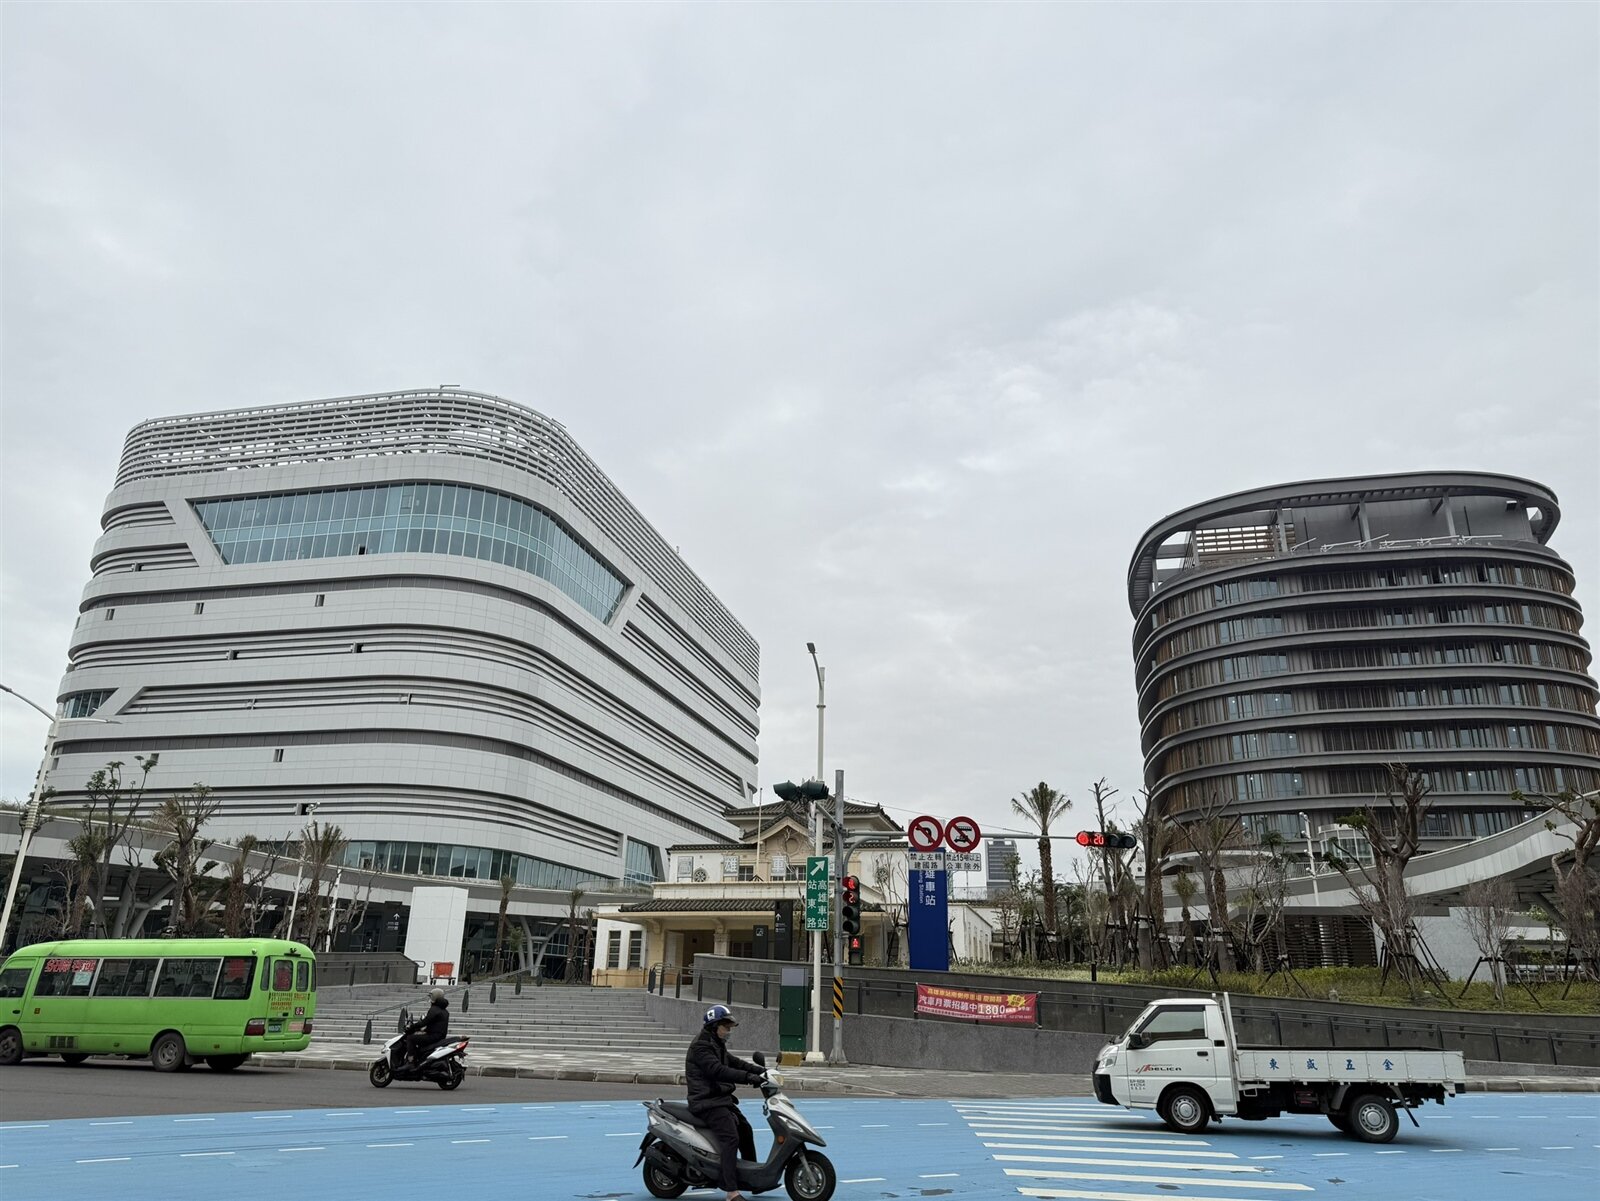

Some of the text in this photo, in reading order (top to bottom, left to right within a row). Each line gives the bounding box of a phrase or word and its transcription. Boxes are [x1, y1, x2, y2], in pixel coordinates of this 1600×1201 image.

[1093, 833, 1104, 845] 20
[910, 853, 942, 861] 禁止左轉
[914, 861, 938, 869] 建國路
[946, 862, 981, 870] 公車除外
[807, 880, 817, 929] 站東路
[817, 880, 827, 929] 高雄車站
[295, 1007, 304, 1015] 82
[978, 1003, 1006, 1015] 1800
[1269, 1058, 1394, 1071] 東盛五金
